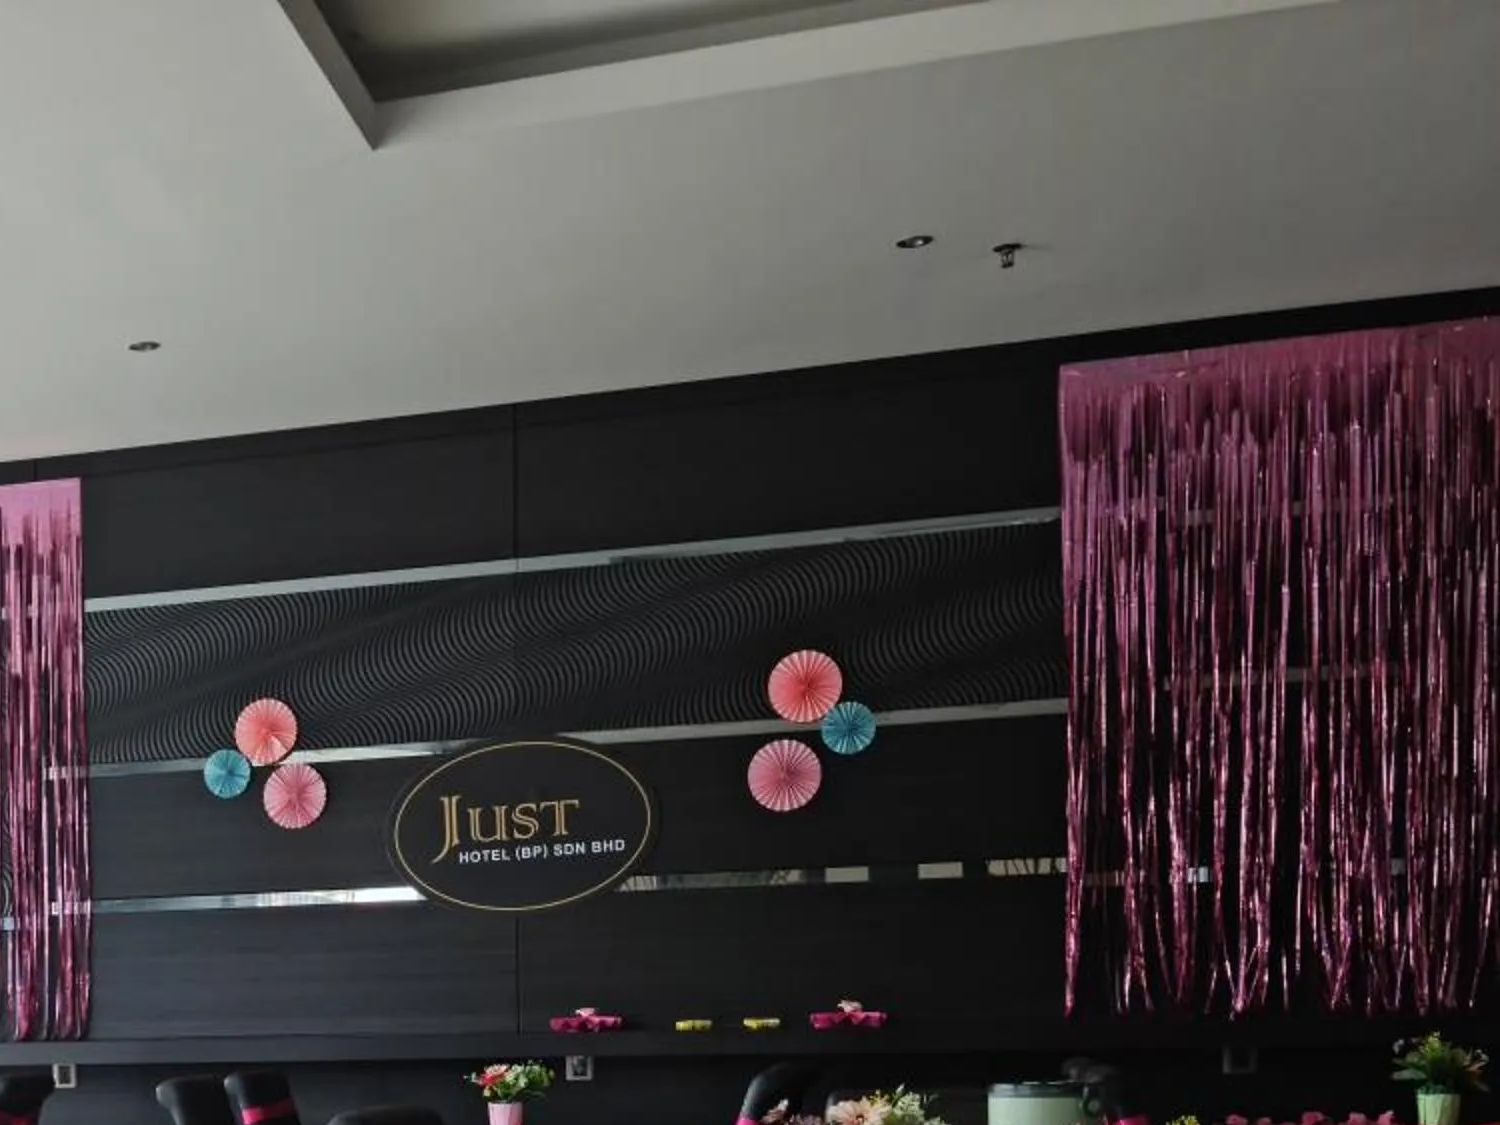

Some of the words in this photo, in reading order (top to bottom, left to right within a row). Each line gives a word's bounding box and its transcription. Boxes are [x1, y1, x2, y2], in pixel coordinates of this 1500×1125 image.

[458, 848, 511, 865] HOTEL
[514, 844, 549, 862] (BP)
[553, 841, 586, 857] SDN
[591, 838, 626, 854] BHD
